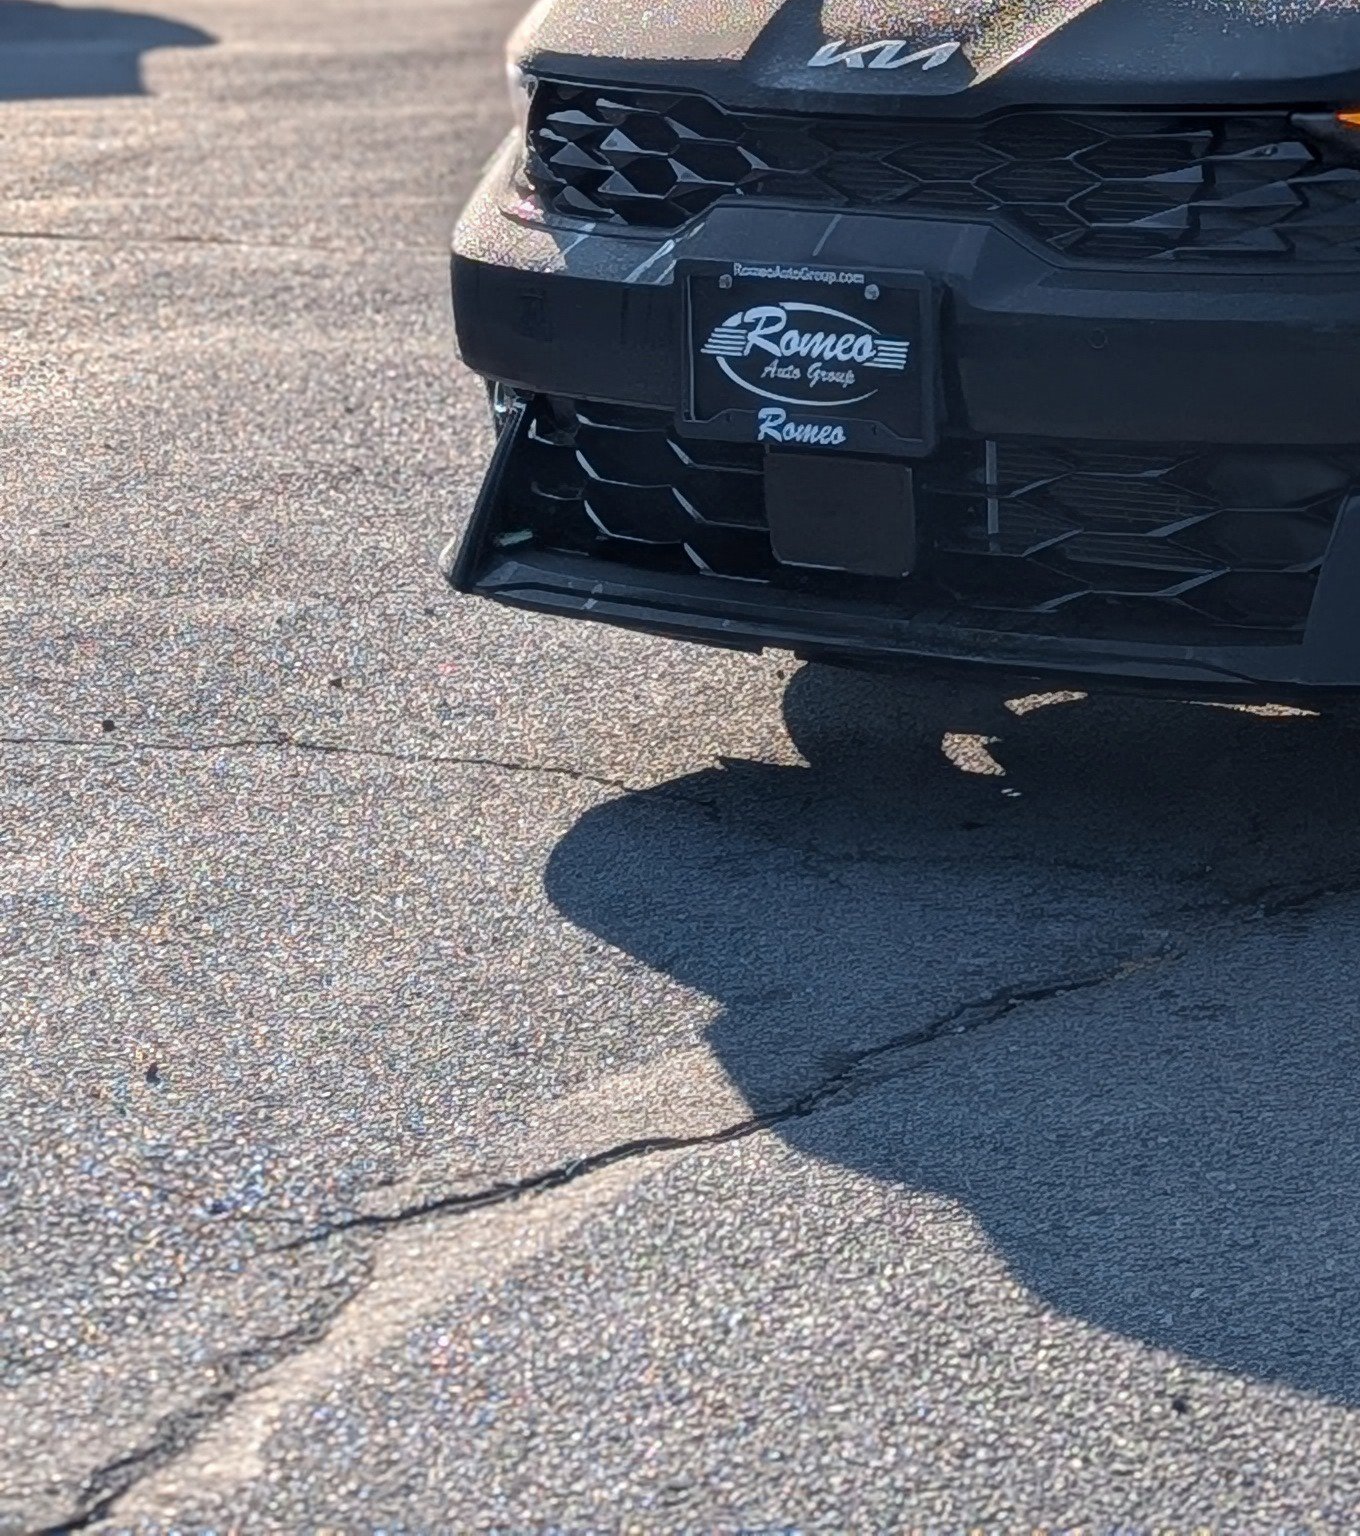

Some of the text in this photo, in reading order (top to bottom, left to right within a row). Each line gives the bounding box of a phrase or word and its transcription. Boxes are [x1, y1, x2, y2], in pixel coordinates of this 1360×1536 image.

[743, 306, 876, 361] Romeo
[761, 359, 856, 388] Auto Group
[757, 407, 846, 445] Romeo
